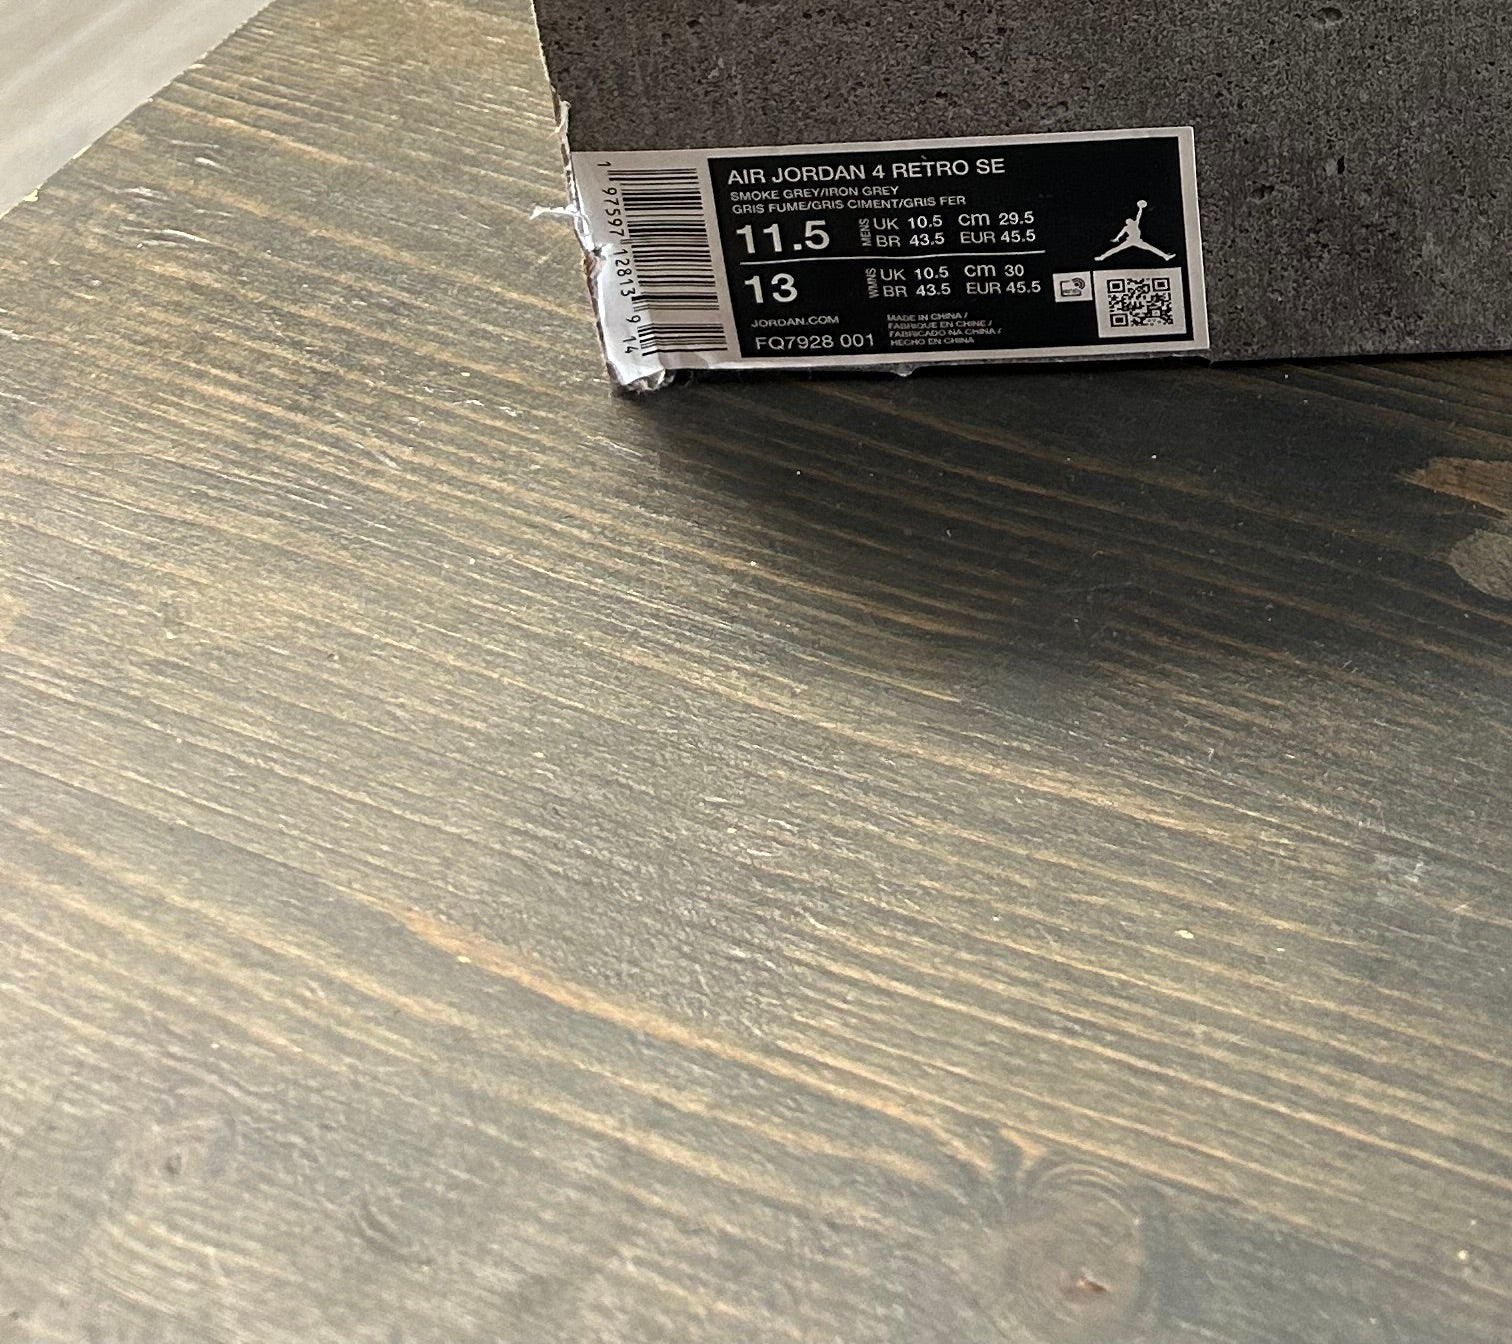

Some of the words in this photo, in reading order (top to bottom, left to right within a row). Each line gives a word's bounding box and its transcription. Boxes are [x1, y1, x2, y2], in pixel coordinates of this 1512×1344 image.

[727, 168, 767, 185] AIR
[772, 164, 866, 184] JORDAN
[872, 164, 886, 180] 4
[892, 159, 969, 179] RETRO
[976, 158, 1006, 175] SE
[730, 189, 780, 201] SMOKE
[783, 187, 859, 199] GREY/IRON
[862, 185, 899, 196] GREY
[602, 187, 625, 237] 97597
[732, 204, 765, 214] GRIS
[769, 200, 845, 212] FUME/GRIS
[847, 197, 936, 209] CIMENT/GRIS
[940, 195, 966, 206] FER
[873, 217, 900, 231] UK
[907, 214, 943, 229] 10.5
[958, 213, 991, 226] cm
[998, 211, 1035, 226] 29.5
[736, 219, 830, 254] 11.5
[859, 218, 873, 247] MENS
[876, 235, 901, 248] BR
[909, 232, 945, 247] 43.5
[960, 231, 997, 244] EUR
[1000, 228, 1036, 243] 45.5
[614, 248, 636, 297] 12813
[880, 268, 907, 281] UK
[914, 265, 949, 280] 10.5
[964, 264, 997, 278] cm
[1004, 264, 1025, 277] 30
[744, 272, 798, 304] 13
[865, 267, 880, 299] WMNS
[882, 285, 908, 298] BR
[915, 282, 951, 297] 43.5
[966, 282, 1002, 295] EUR
[1006, 280, 1042, 294] 45.5
[626, 315, 641, 323] 9
[751, 315, 840, 328] JORDAN.COM
[930, 312, 962, 320] CHINA
[622, 335, 639, 354] 14
[755, 334, 835, 351] FQ7928
[840, 332, 874, 348] 001
